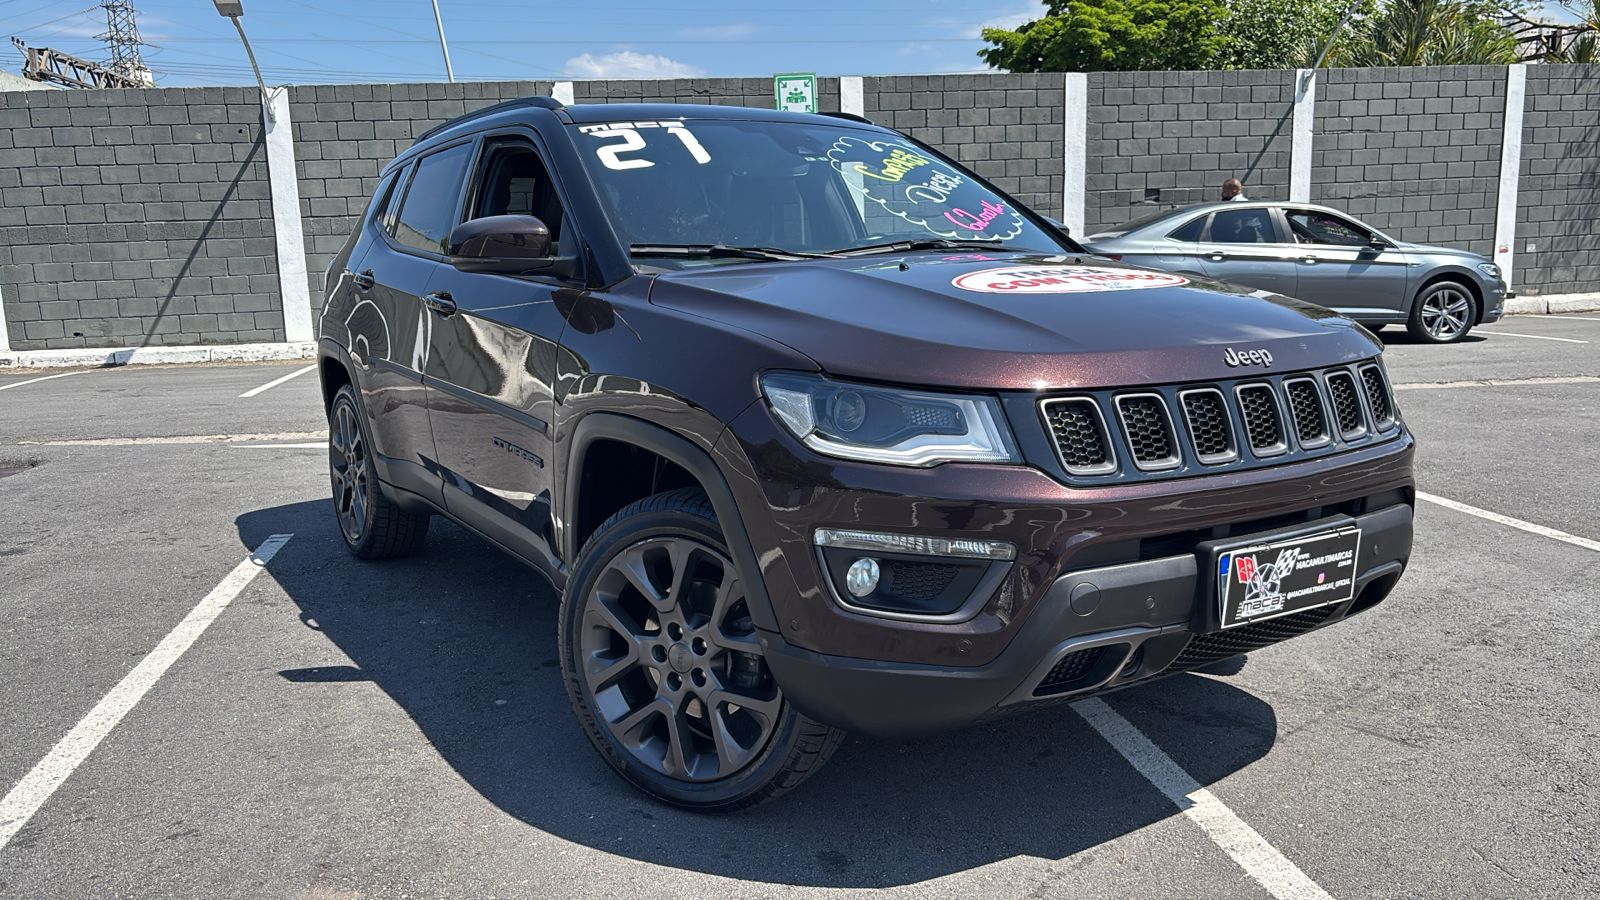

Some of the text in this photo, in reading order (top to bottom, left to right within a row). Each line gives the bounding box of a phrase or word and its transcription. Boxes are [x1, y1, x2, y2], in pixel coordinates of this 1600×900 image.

[589, 127, 711, 170] 21
[987, 276, 1070, 290] COM
[1224, 347, 1273, 368] Jeep
[1295, 549, 1353, 570] MACAMULTIMARCAS
